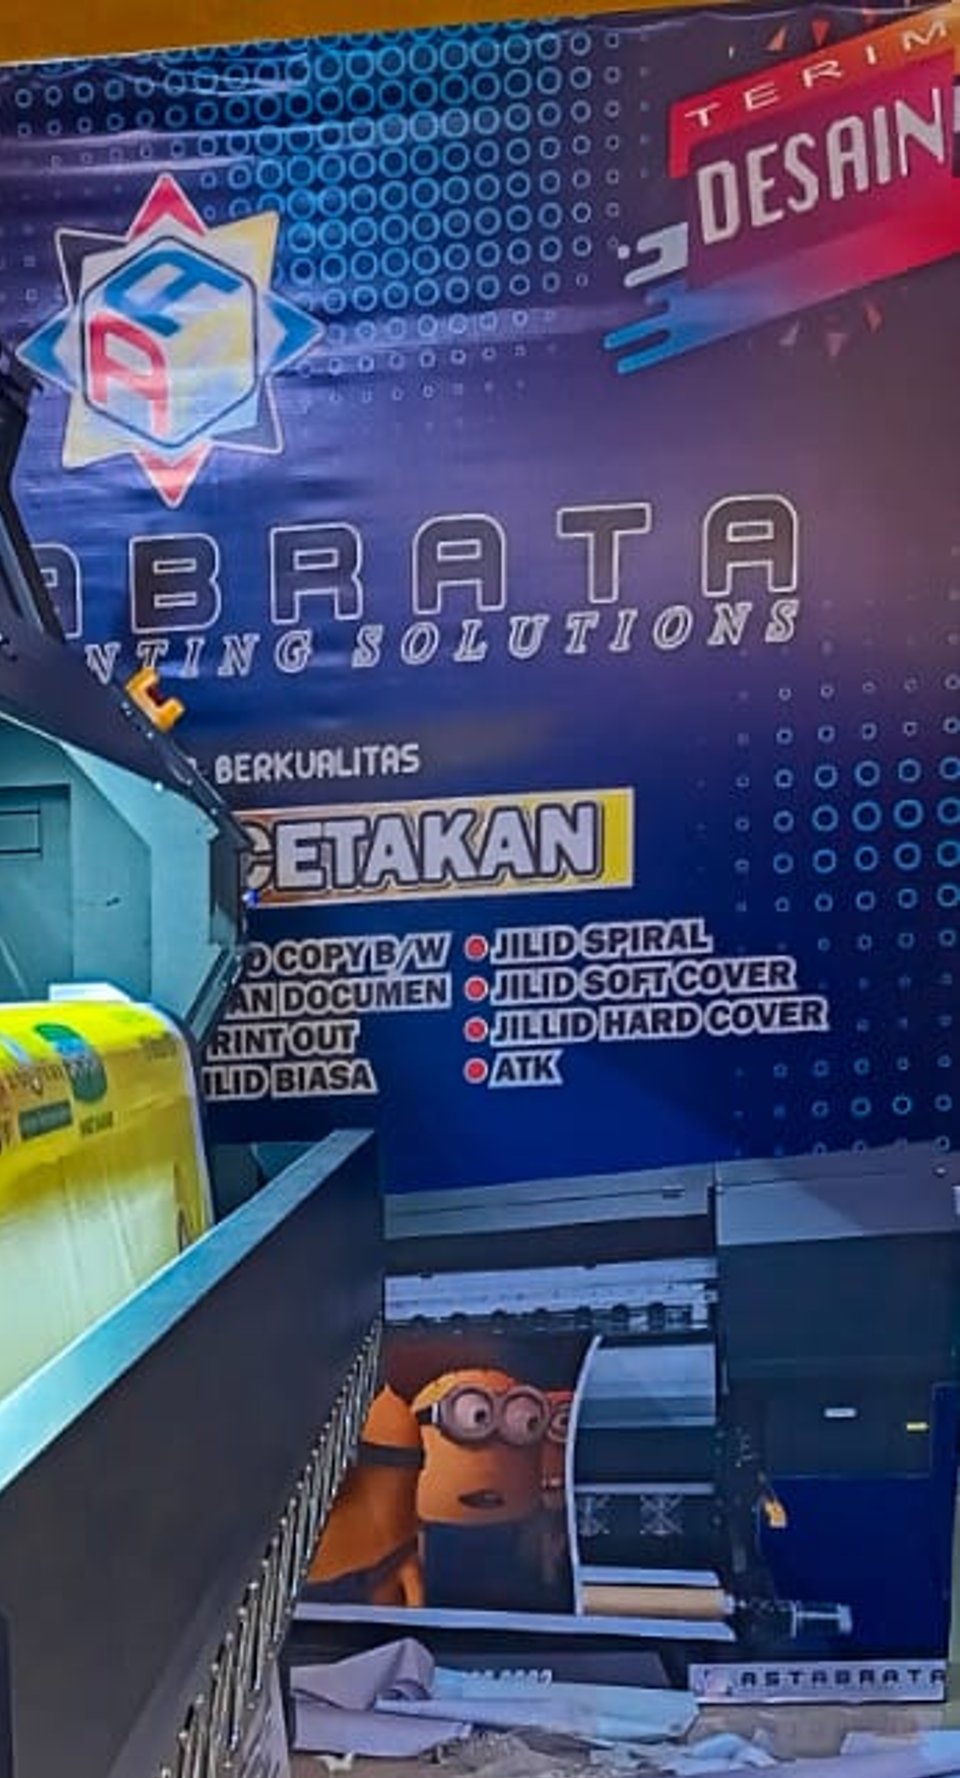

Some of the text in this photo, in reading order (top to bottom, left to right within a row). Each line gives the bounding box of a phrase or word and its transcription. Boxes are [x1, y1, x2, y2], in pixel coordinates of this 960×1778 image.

[696, 87, 946, 246] DESAIN
[352, 600, 799, 668] SOLUTIONS
[214, 743, 421, 785] BERKUALITAS
[275, 941, 366, 975] COPY
[370, 933, 450, 973] B/W
[493, 919, 712, 963] JILID SPIRAL
[283, 975, 451, 1015] DOCUMEN
[493, 957, 796, 1003] JILID SOFT COVER
[292, 1020, 360, 1055] OUT
[493, 997, 829, 1045] JILLID HARD COVER
[271, 1060, 377, 1096] BIASA
[490, 1049, 563, 1088] ATK
